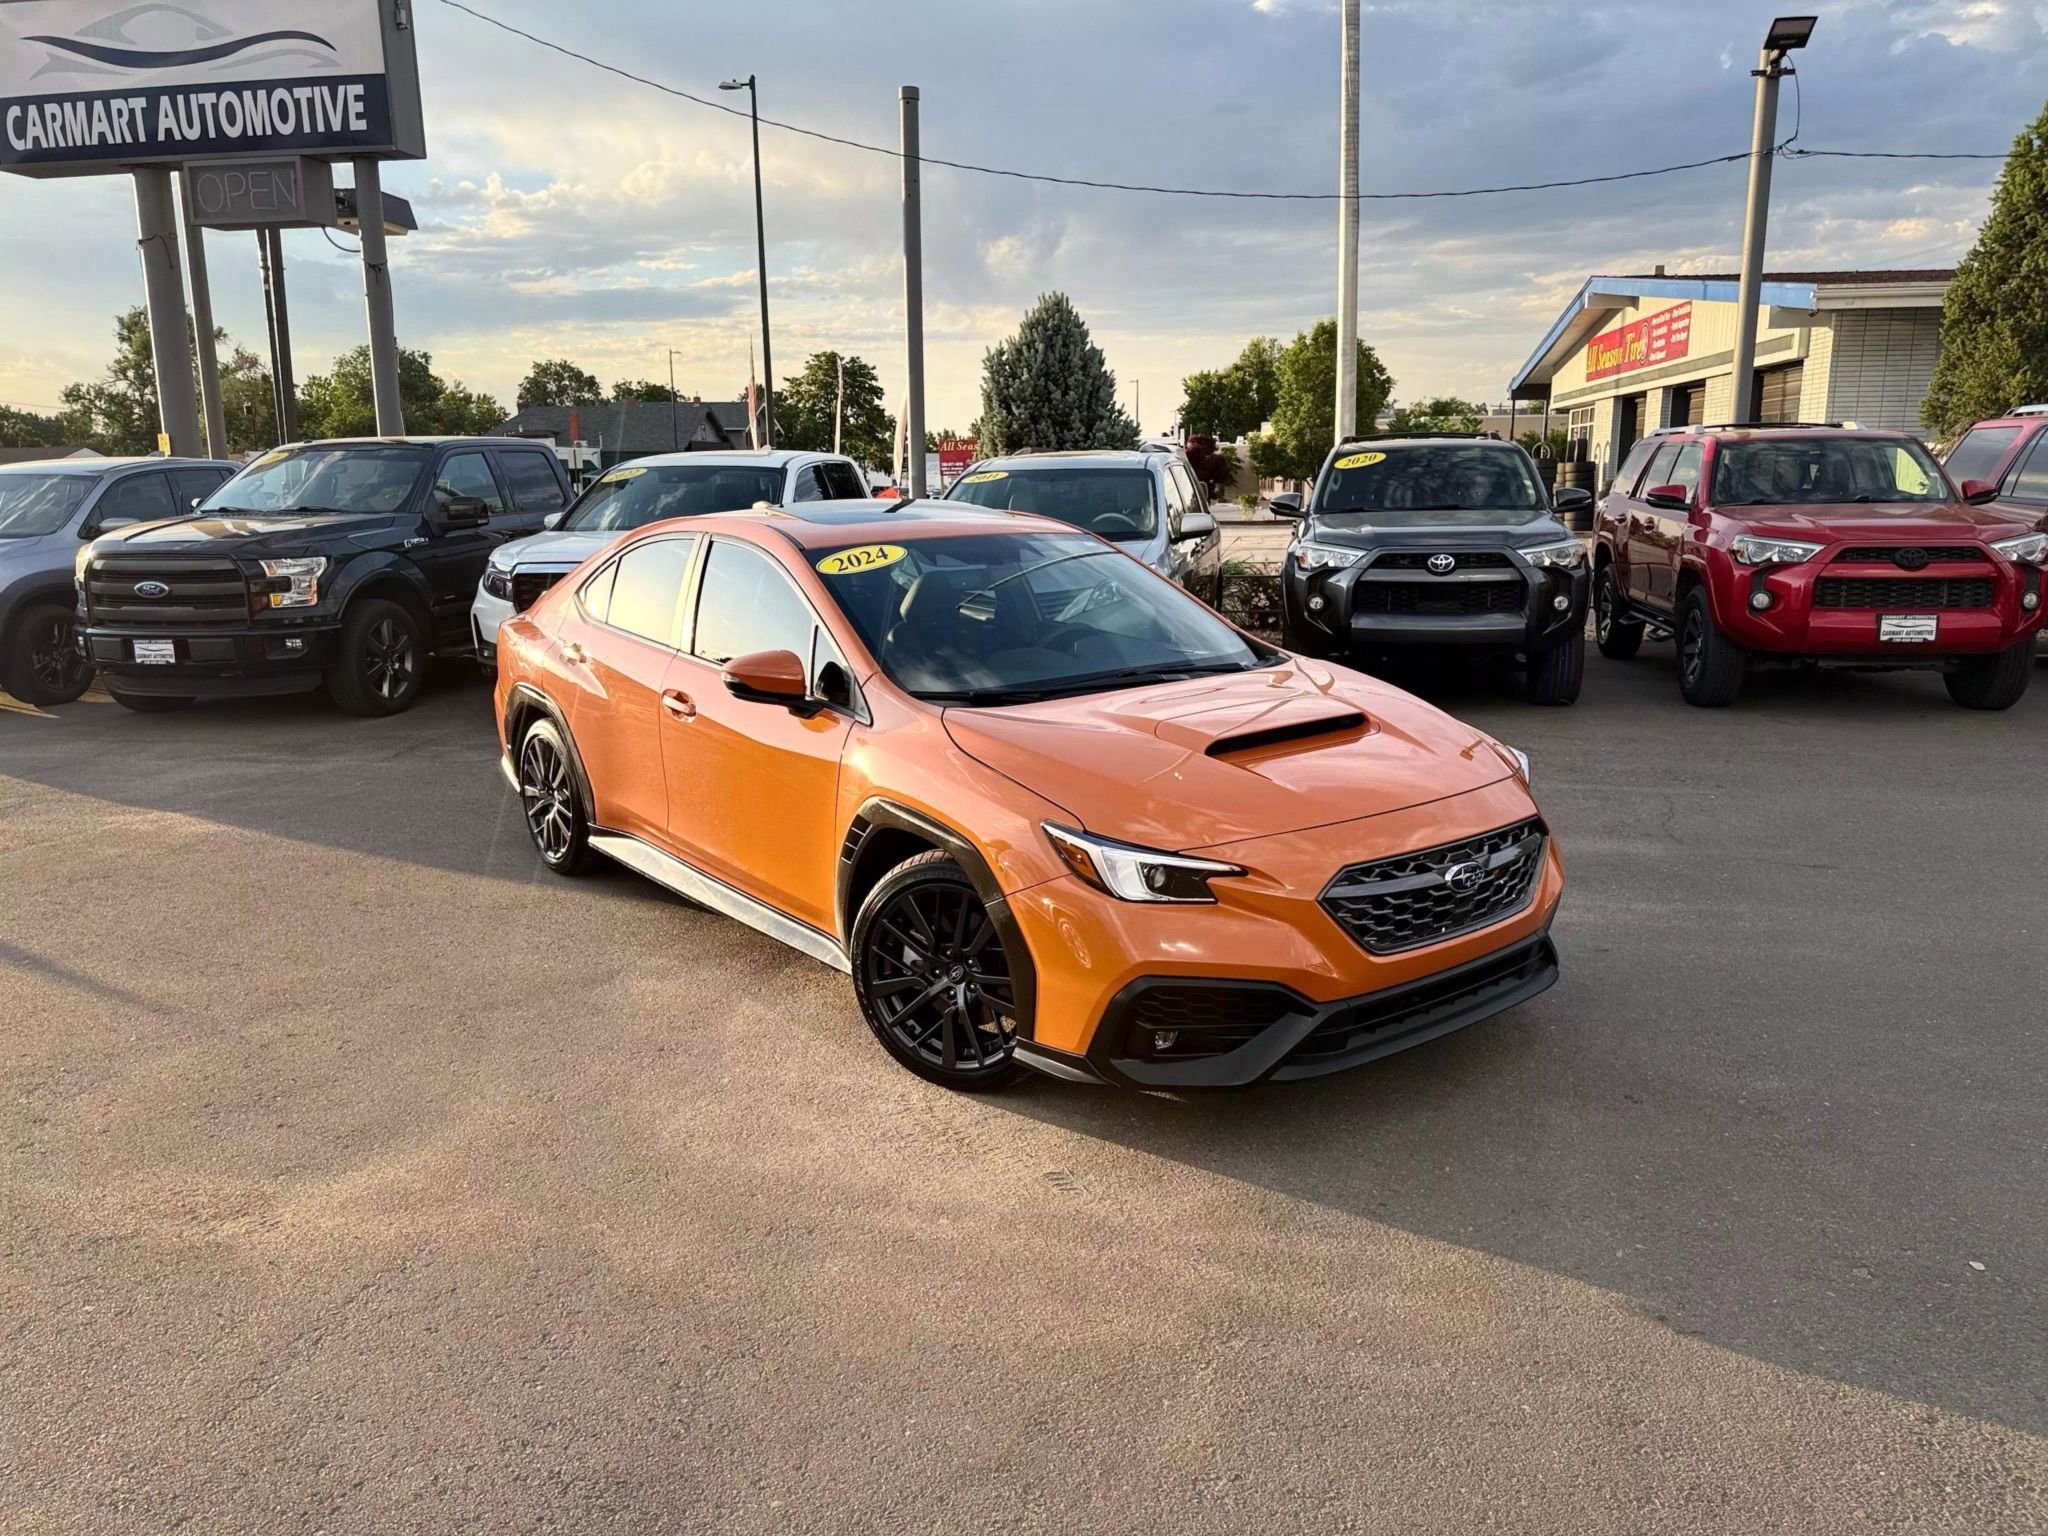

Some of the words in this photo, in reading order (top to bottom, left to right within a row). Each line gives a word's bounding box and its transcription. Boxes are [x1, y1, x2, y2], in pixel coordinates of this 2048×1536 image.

[6, 97, 147, 151] CARMART
[157, 84, 368, 142] AUTOMOTIVE
[198, 169, 296, 213] OPEN
[940, 441, 955, 451] All
[957, 441, 977, 451] Seas
[1344, 454, 1377, 466] 2020
[832, 547, 888, 572] 2024
